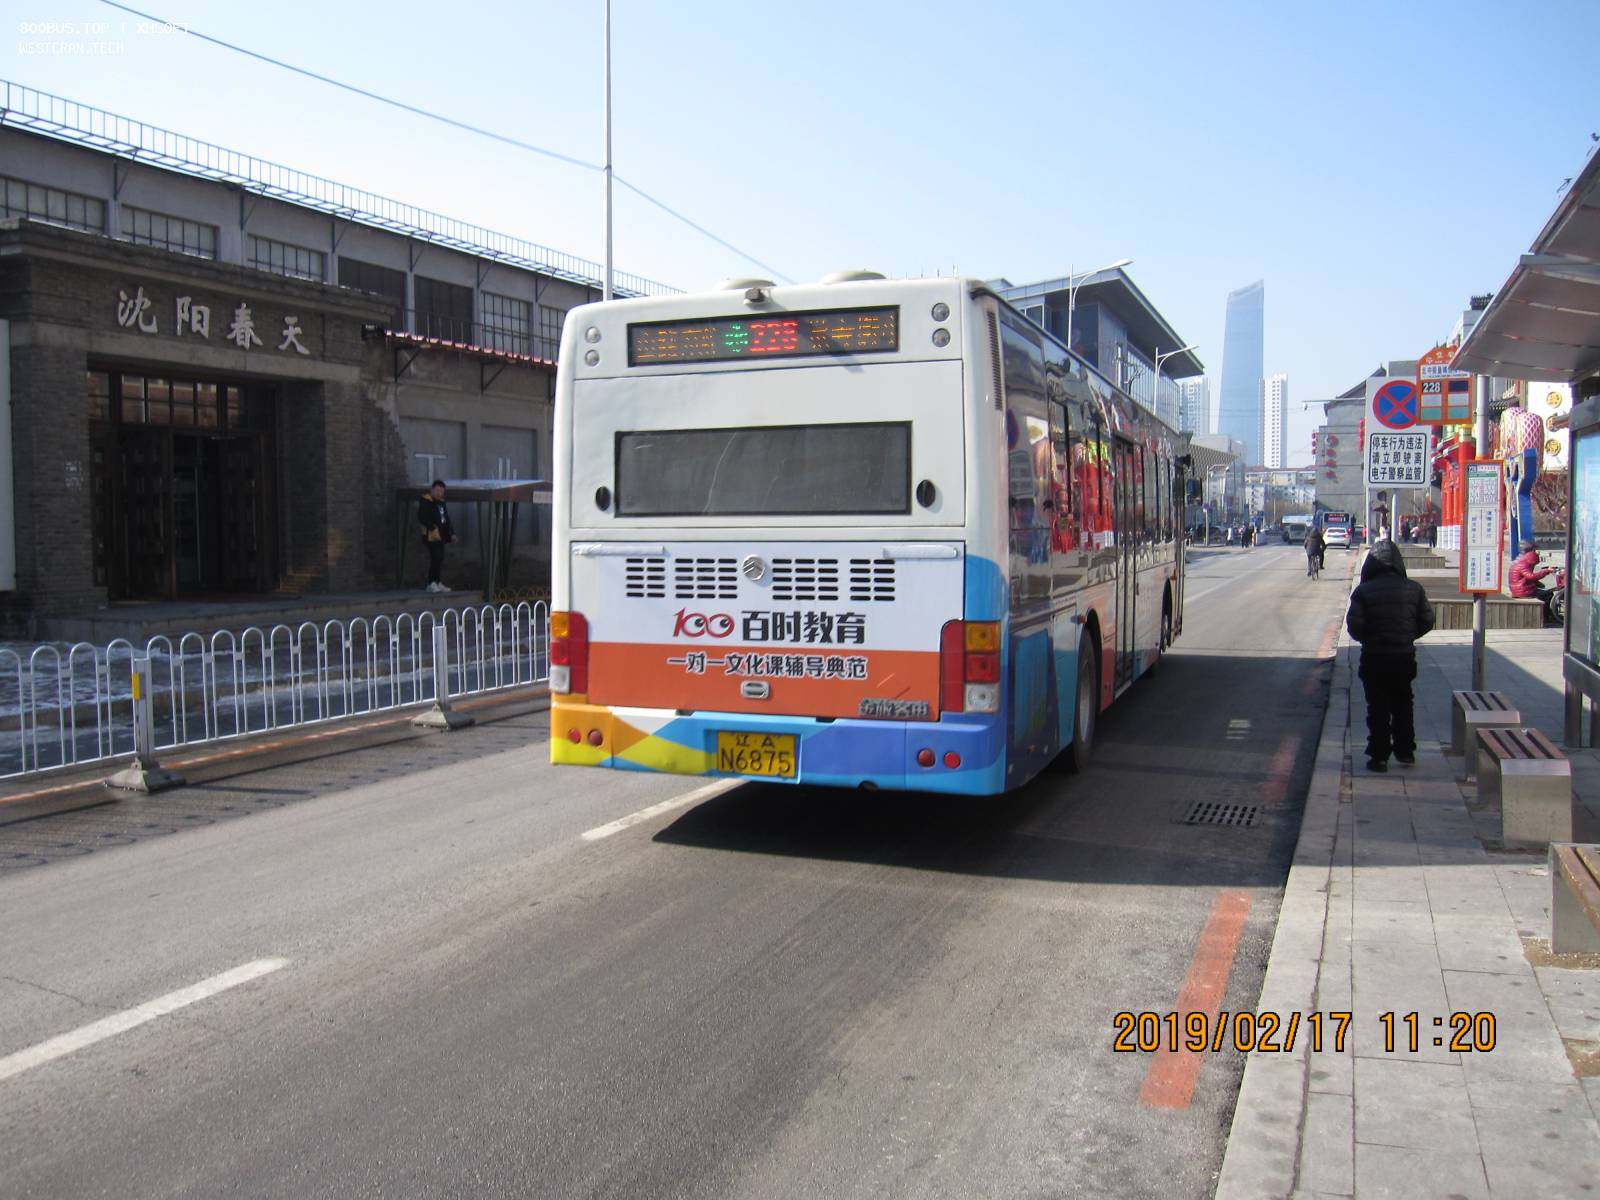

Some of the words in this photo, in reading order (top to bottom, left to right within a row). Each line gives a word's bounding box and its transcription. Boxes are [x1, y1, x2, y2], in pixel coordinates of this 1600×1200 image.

[117, 286, 311, 355] 沈阳春天
[1422, 382, 1441, 393] 228
[1372, 436, 1423, 450] 停车行为违法
[1372, 451, 1422, 465] 请立即驶离
[1371, 466, 1422, 480] 电子警察监管
[672, 607, 735, 638] 100
[741, 611, 867, 645] 百时教育
[667, 652, 869, 680] 一对一文化课辅导典范
[720, 748, 792, 774] N6875
